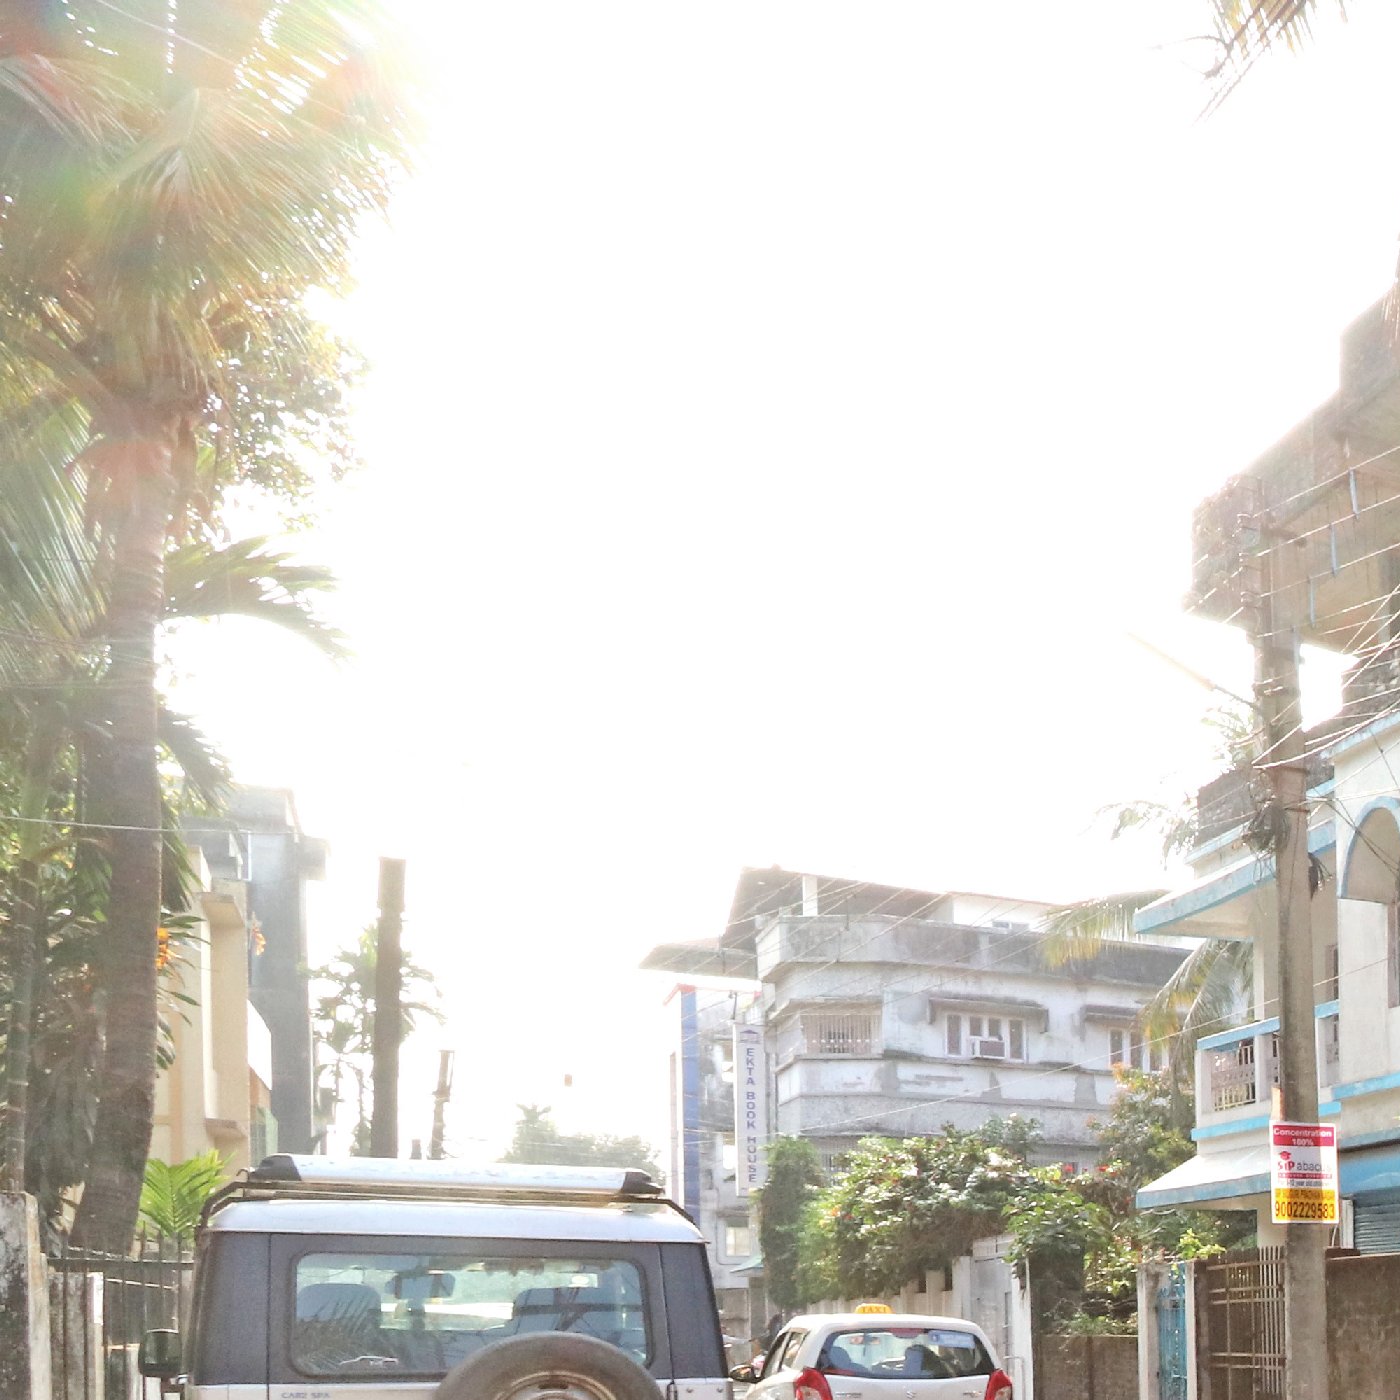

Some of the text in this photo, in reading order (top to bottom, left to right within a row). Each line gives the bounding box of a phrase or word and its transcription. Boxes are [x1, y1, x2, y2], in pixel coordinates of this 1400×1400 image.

[746, 1048, 757, 1182] EKTA BOOK HOUSE
[1273, 1128, 1332, 1137] Concentration
[1275, 1202, 1335, 1218] 9002229583
